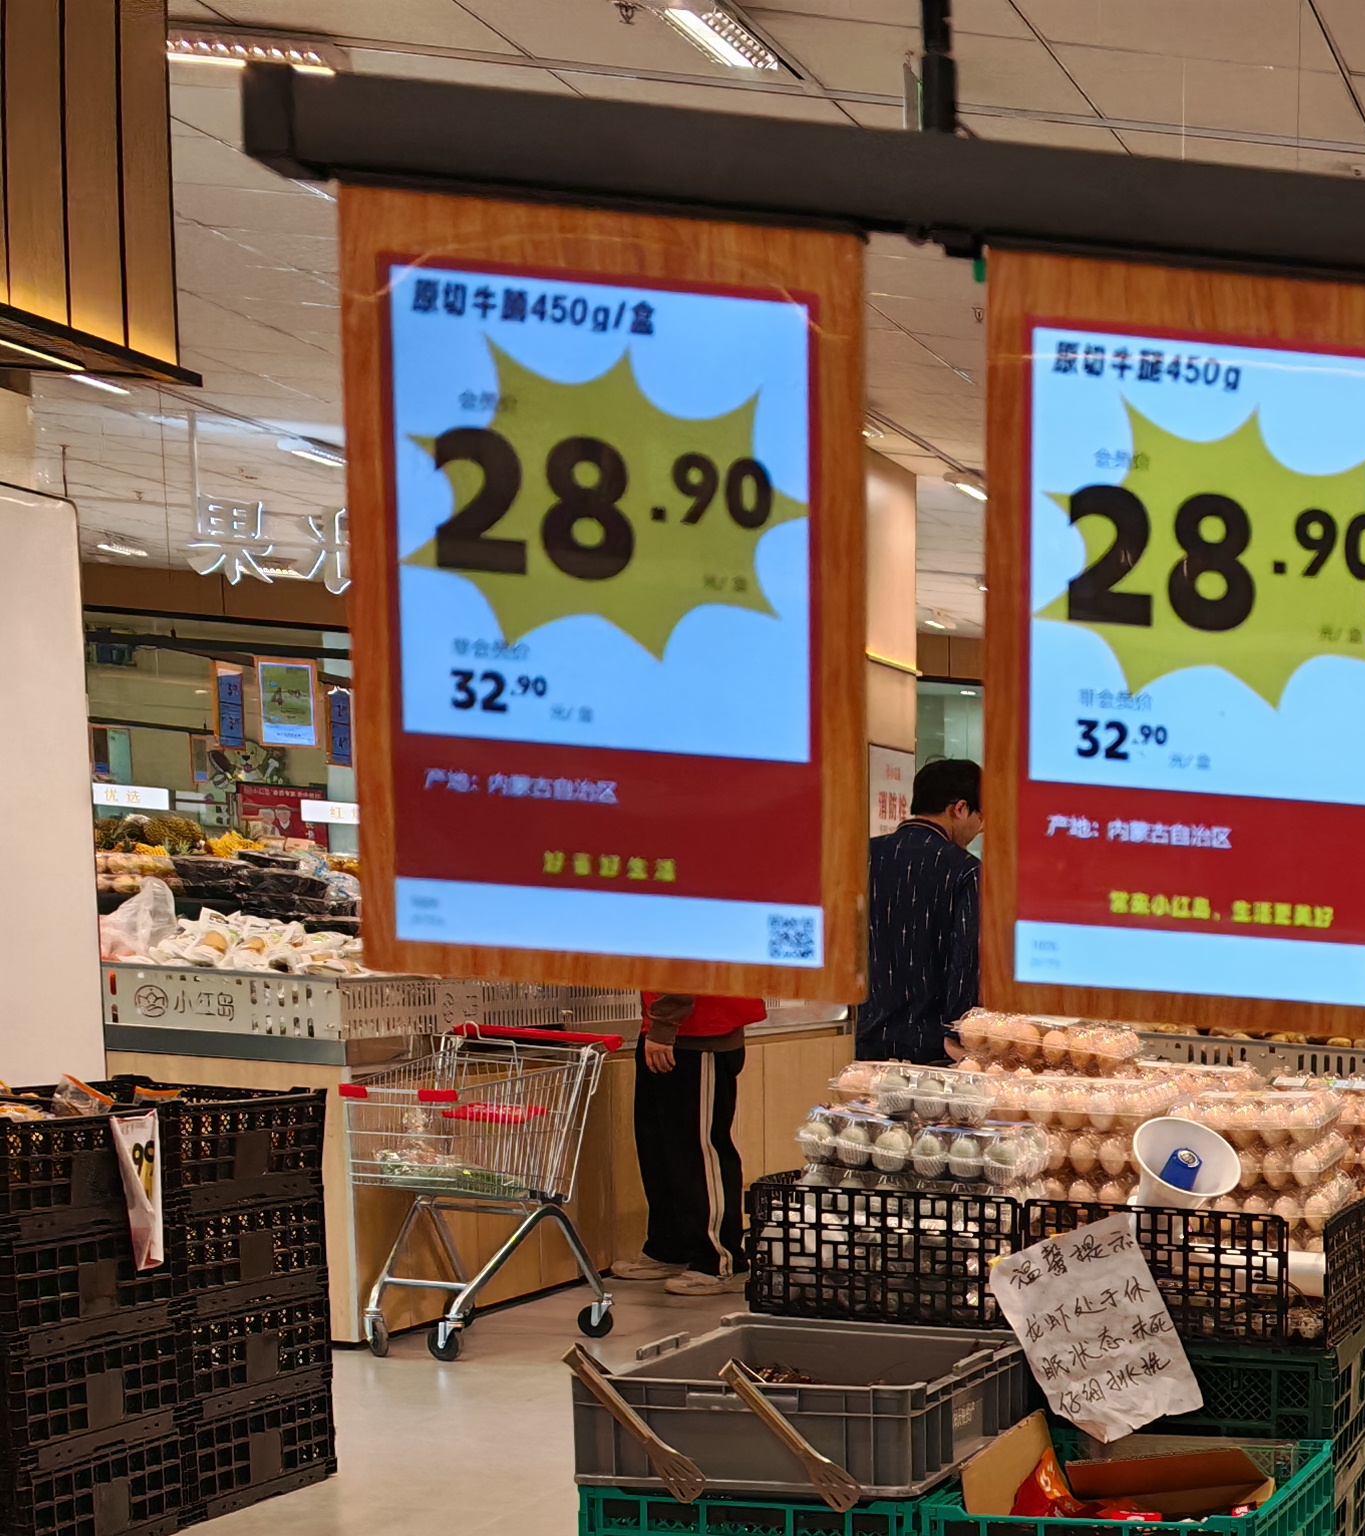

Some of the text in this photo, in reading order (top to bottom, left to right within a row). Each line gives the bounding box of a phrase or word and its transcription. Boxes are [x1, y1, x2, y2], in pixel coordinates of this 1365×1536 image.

[434, 426, 774, 581] 28.90
[449, 668, 548, 713] 32.90
[1076, 718, 1168, 761] 32.90
[104, 788, 141, 804] 优选
[173, 991, 235, 1021] 小红岛
[1009, 1230, 1137, 1290] 温馨提示
[1025, 1275, 1151, 1343] 龙虾处于休
